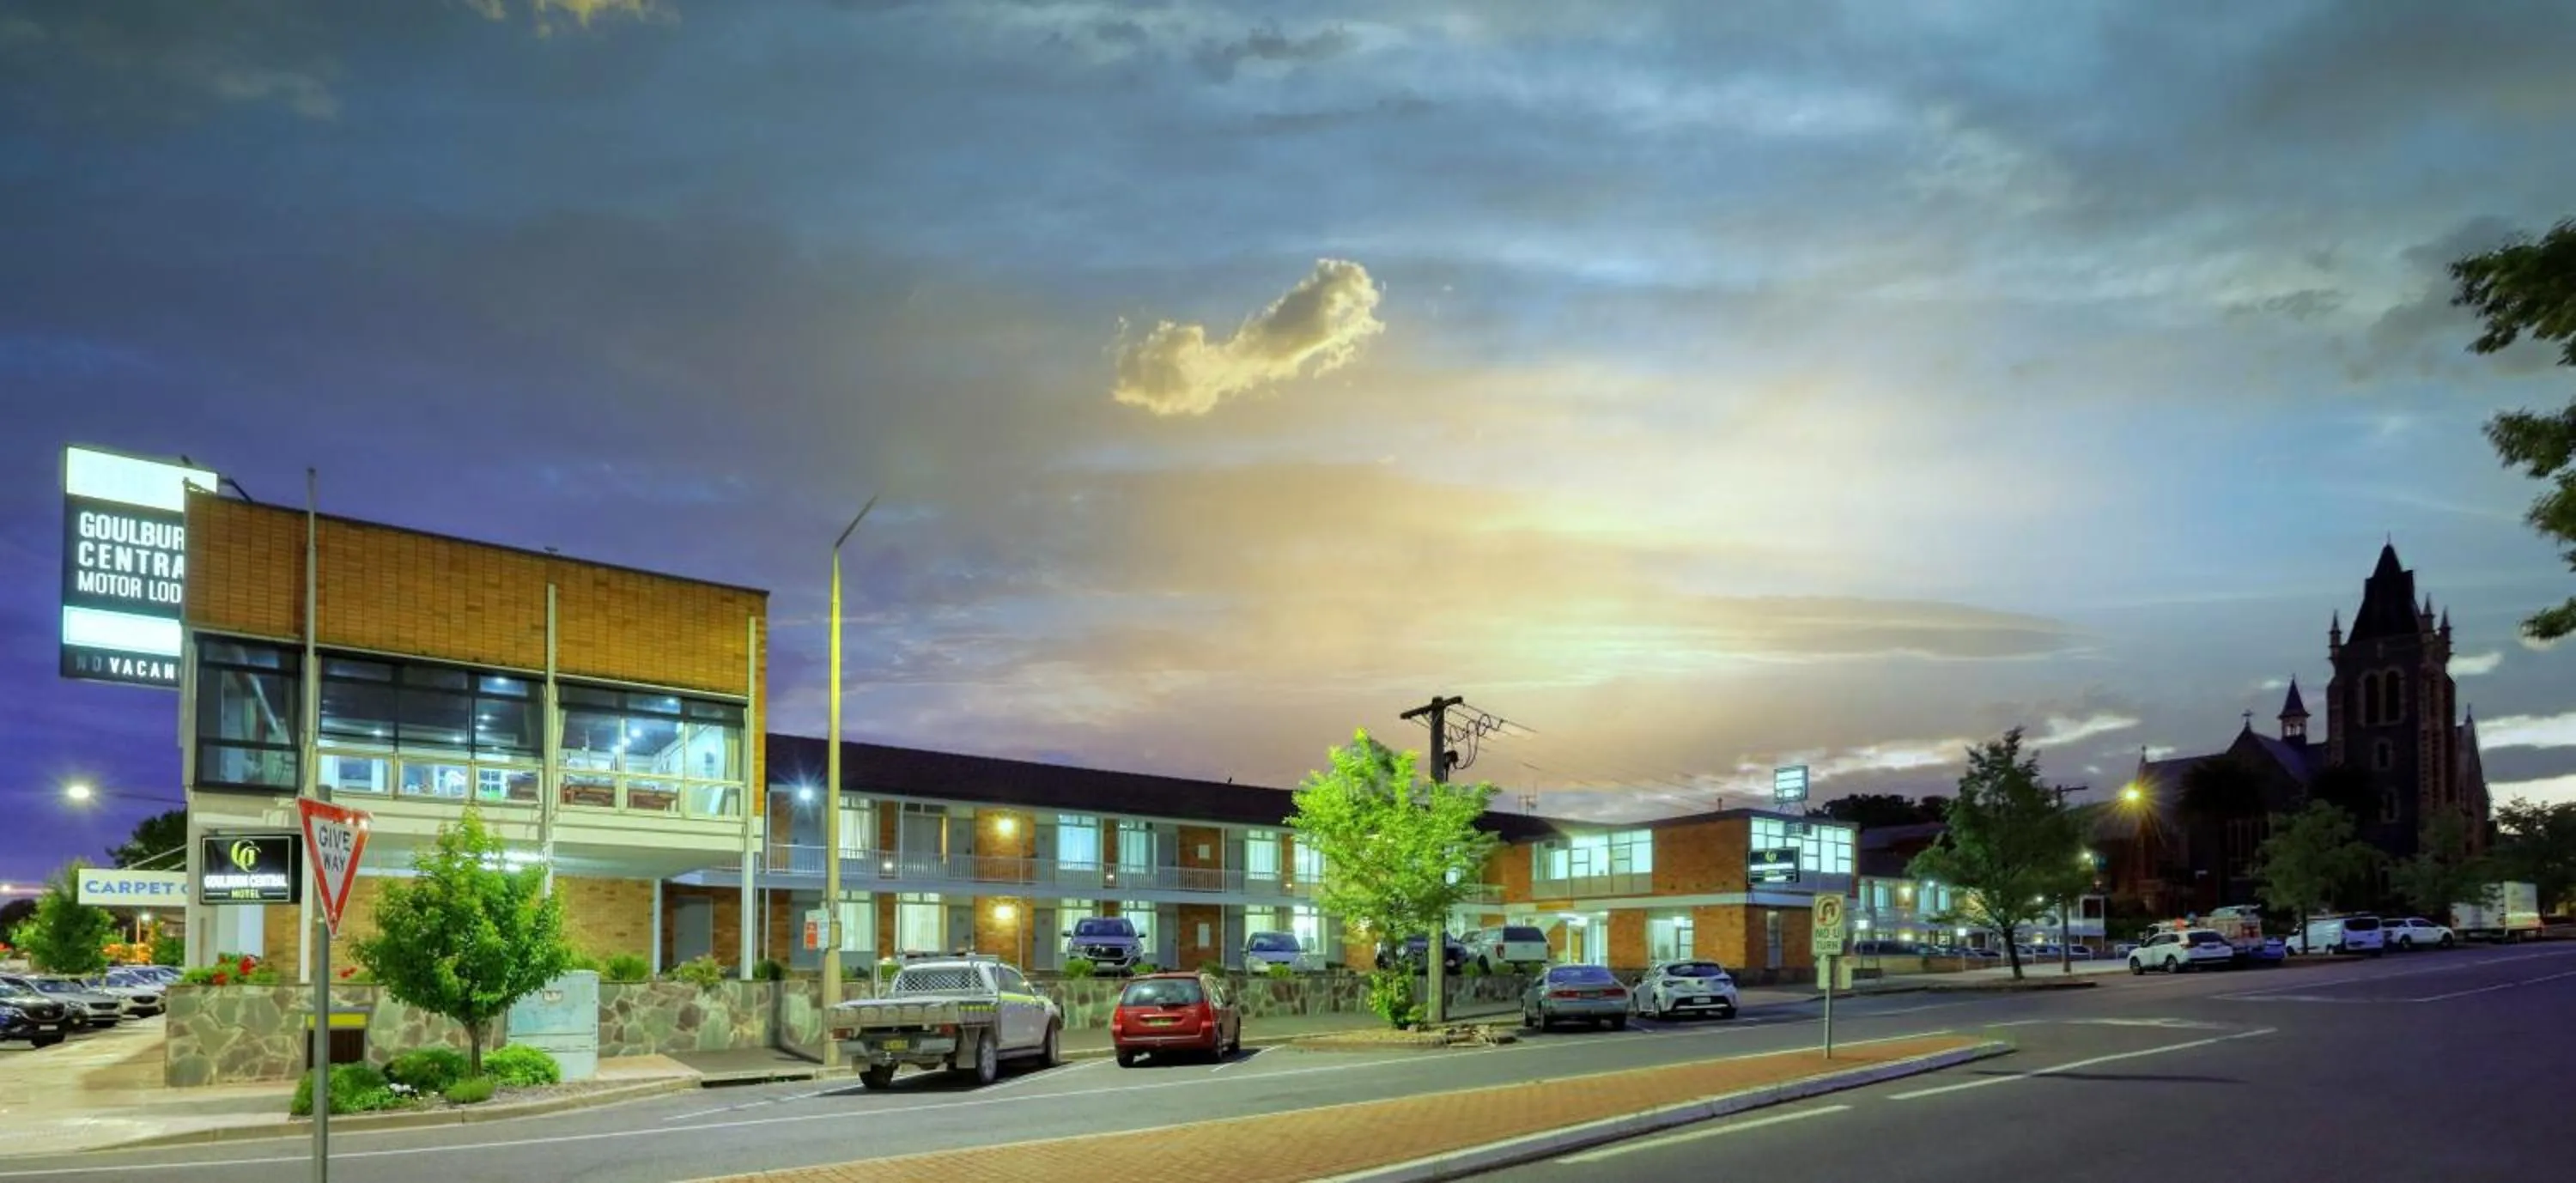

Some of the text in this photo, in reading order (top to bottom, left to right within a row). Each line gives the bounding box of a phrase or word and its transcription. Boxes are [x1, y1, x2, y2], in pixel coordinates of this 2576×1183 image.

[79, 512, 184, 550] GOULBUR
[78, 541, 184, 579] CENTRA
[77, 570, 181, 604] MOTOR LOD
[109, 657, 182, 679] VACAN
[319, 824, 351, 852] GIVE
[324, 852, 345, 871] WAY
[85, 879, 174, 895] CARPET
[1815, 928, 1840, 938] NO U
[1816, 940, 1839, 950] TURN
